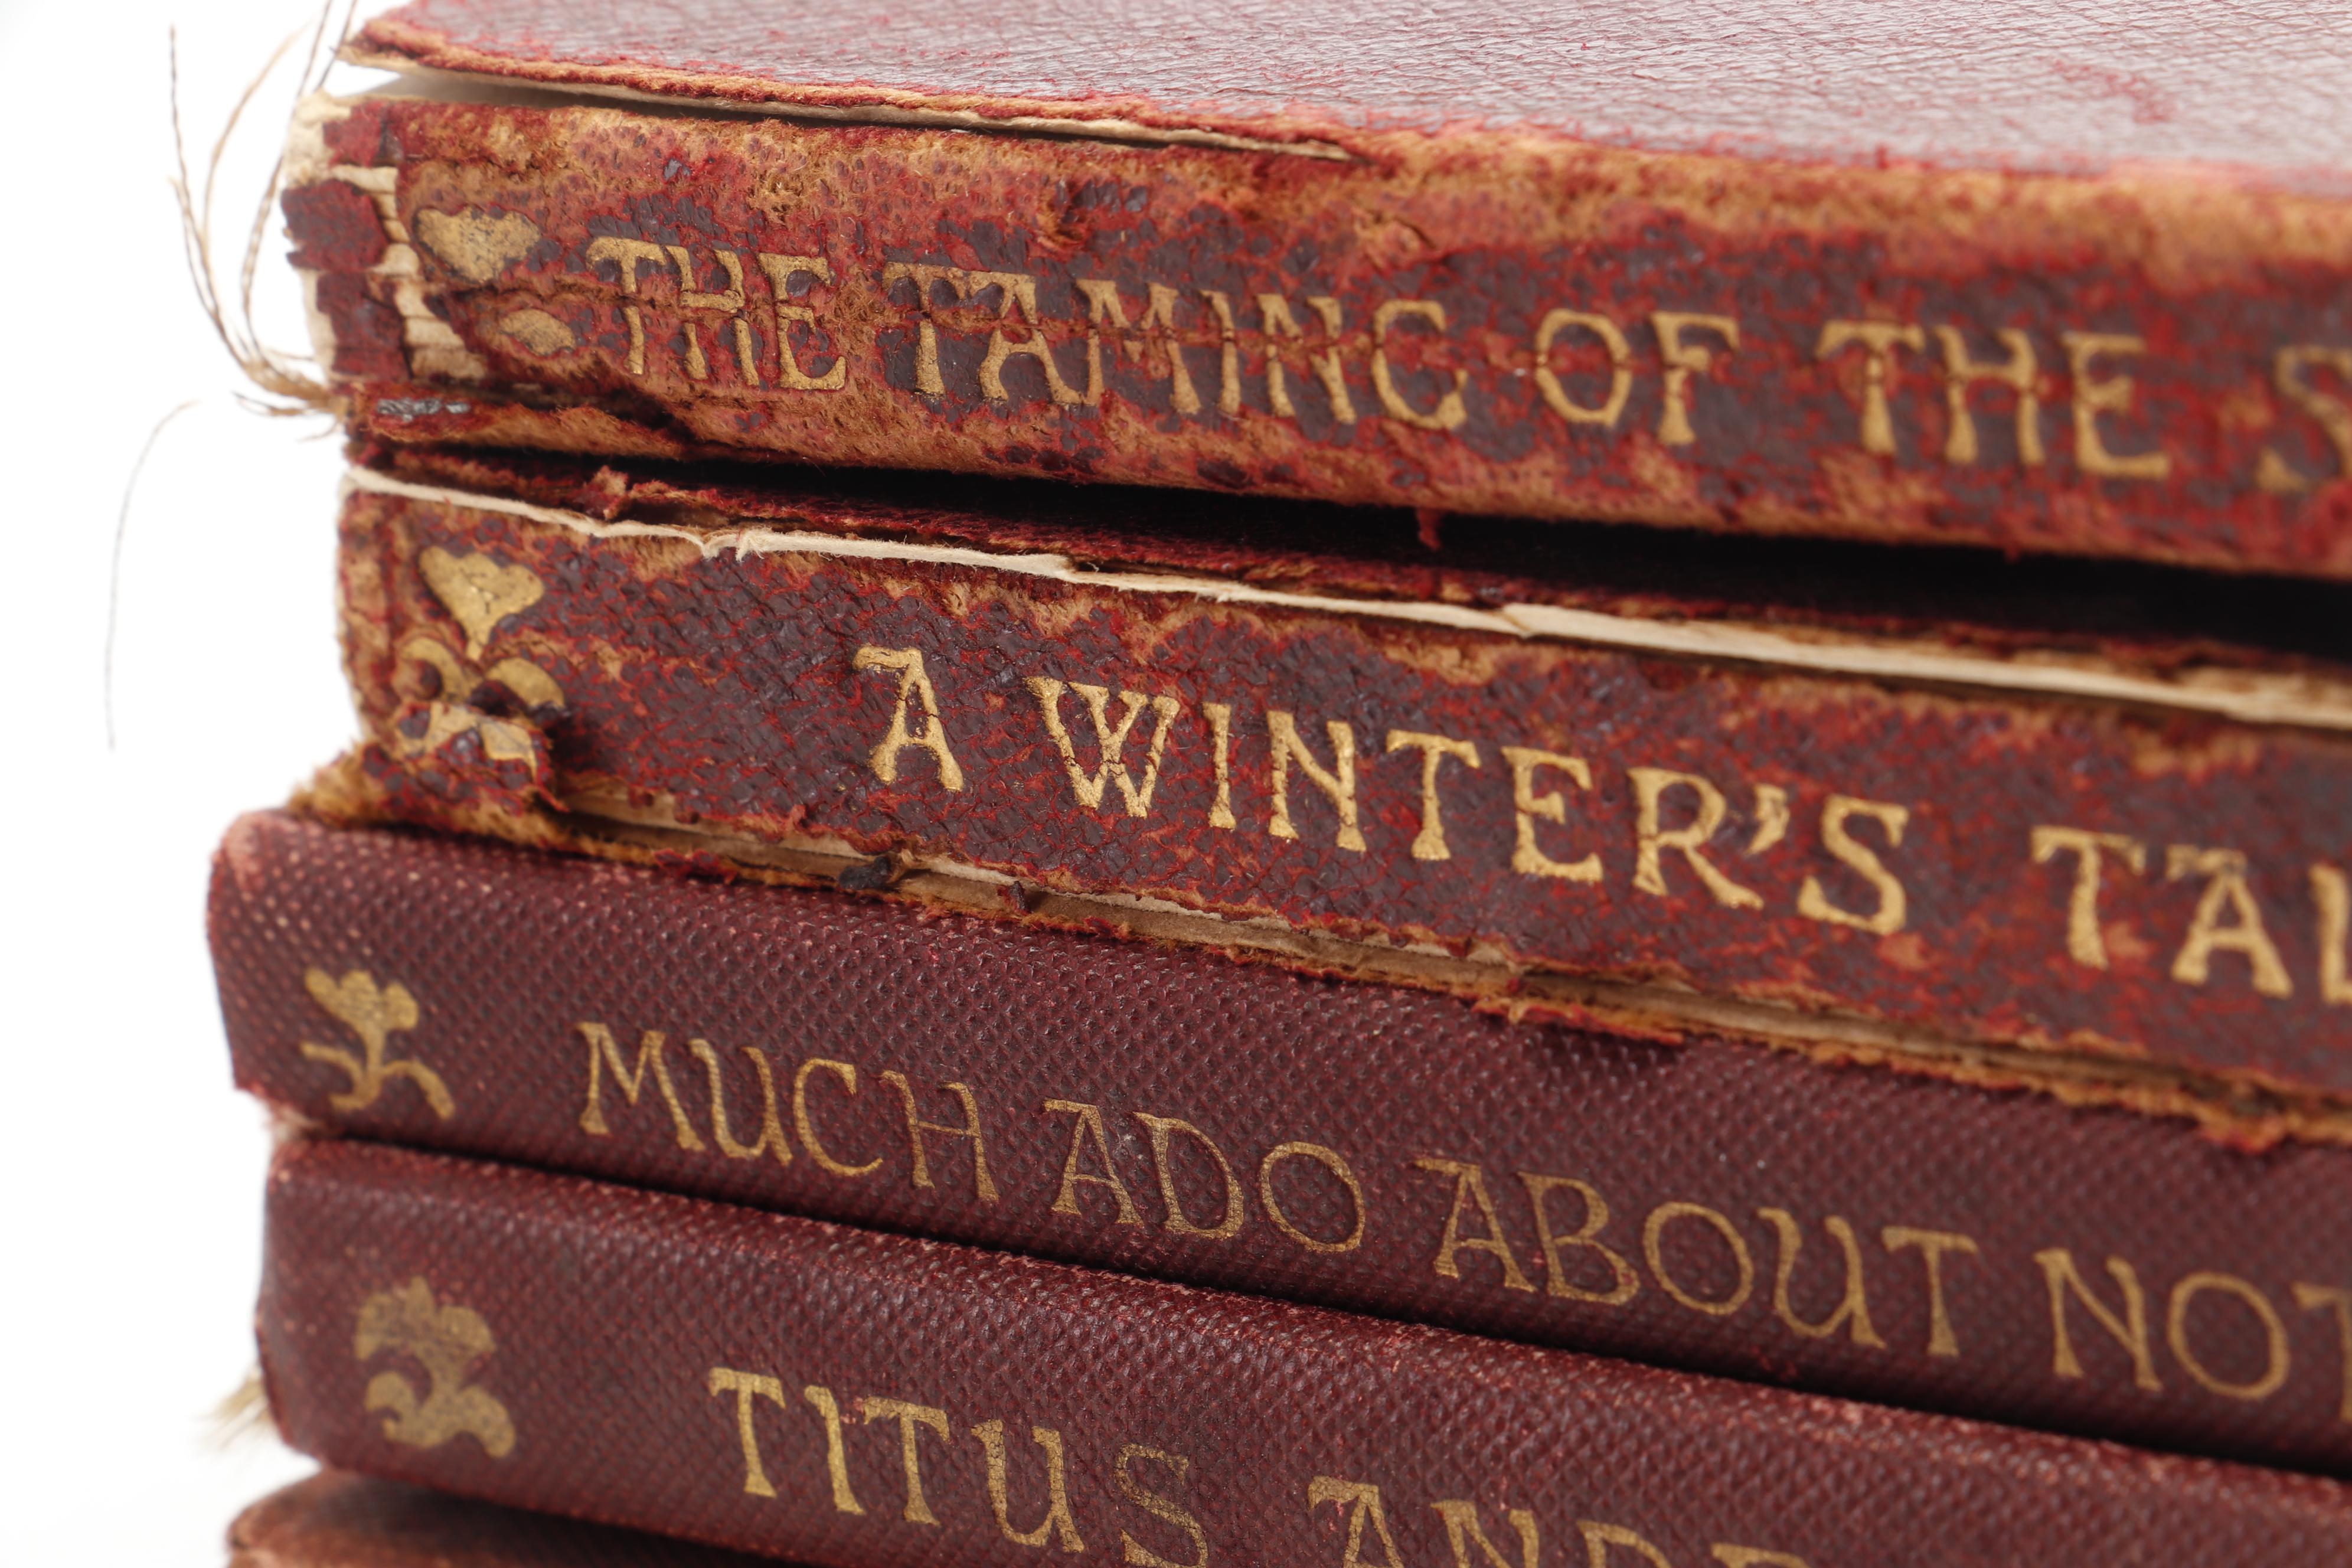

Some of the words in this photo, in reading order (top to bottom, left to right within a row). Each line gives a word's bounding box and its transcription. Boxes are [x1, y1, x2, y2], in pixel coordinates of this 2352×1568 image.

[586, 236, 847, 392] THE
[886, 260, 1469, 431] TAMING
[1535, 308, 1739, 446] OF
[1817, 319, 2170, 479] THE
[852, 643, 963, 792] A
[1024, 676, 1909, 935] WINTER'S
[579, 1021, 1000, 1206] MUCH
[1043, 1098, 1367, 1254] ADO
[1411, 1157, 1978, 1358] ABOUT
[710, 1366, 1209, 1568] TITUS
